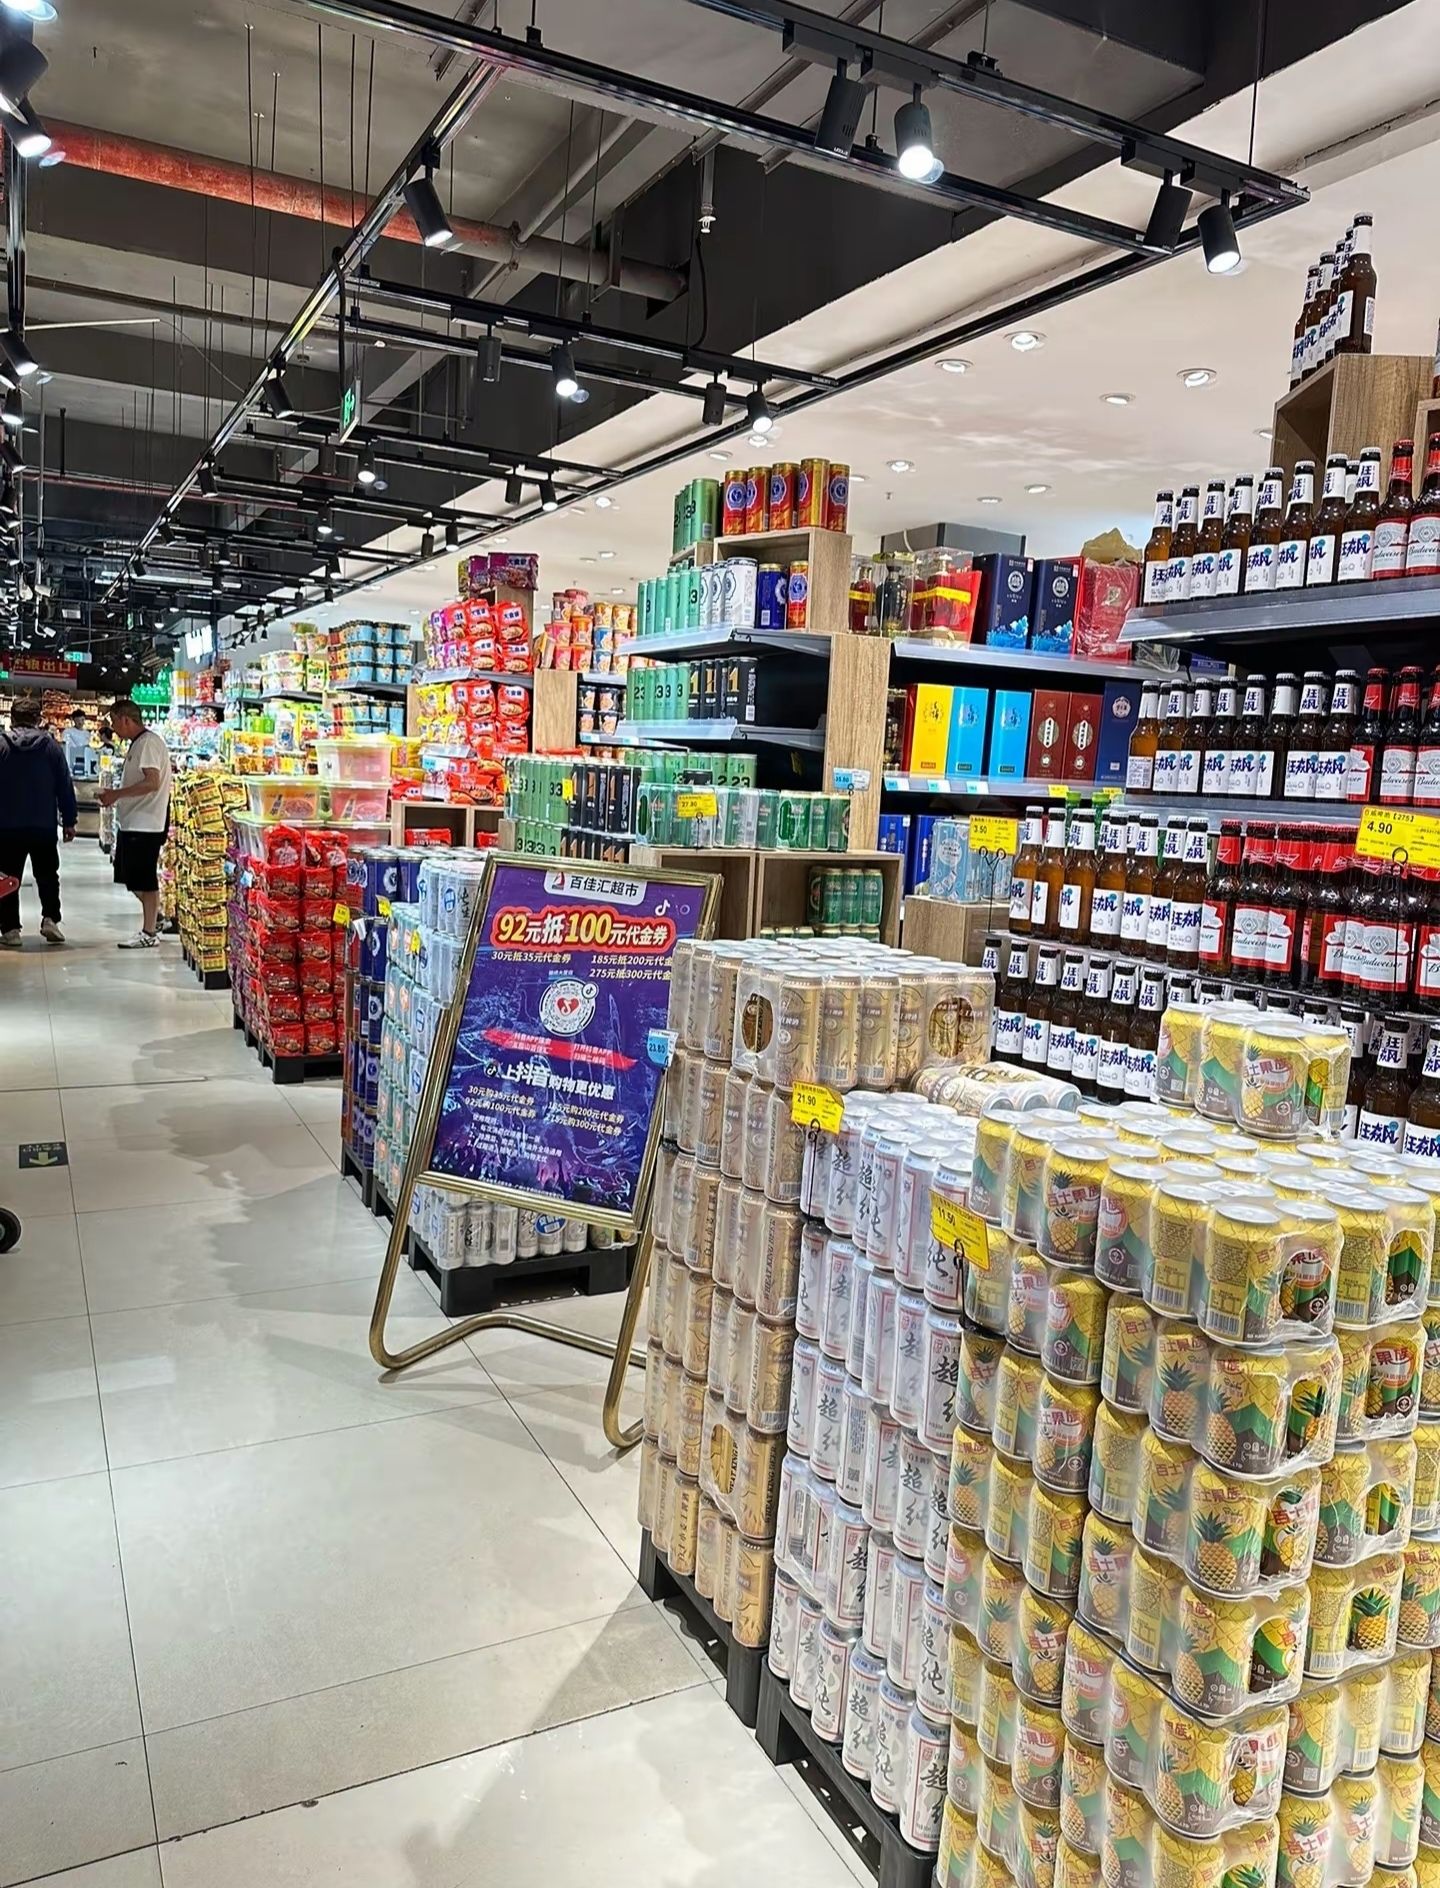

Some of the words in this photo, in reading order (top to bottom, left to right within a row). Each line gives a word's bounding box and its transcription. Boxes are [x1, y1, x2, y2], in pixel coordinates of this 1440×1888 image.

[974, 824, 988, 834] 3.50
[1367, 821, 1392, 835] 4.90
[570, 876, 638, 897] 百佳汇超市
[498, 913, 667, 945] 92元抵100元代金券
[491, 952, 571, 963] 30元抵35元代金券
[1380, 1036, 1402, 1063] 狂飙
[501, 1061, 616, 1100] 上抖音购物更优惠
[797, 1093, 817, 1107] 21.90
